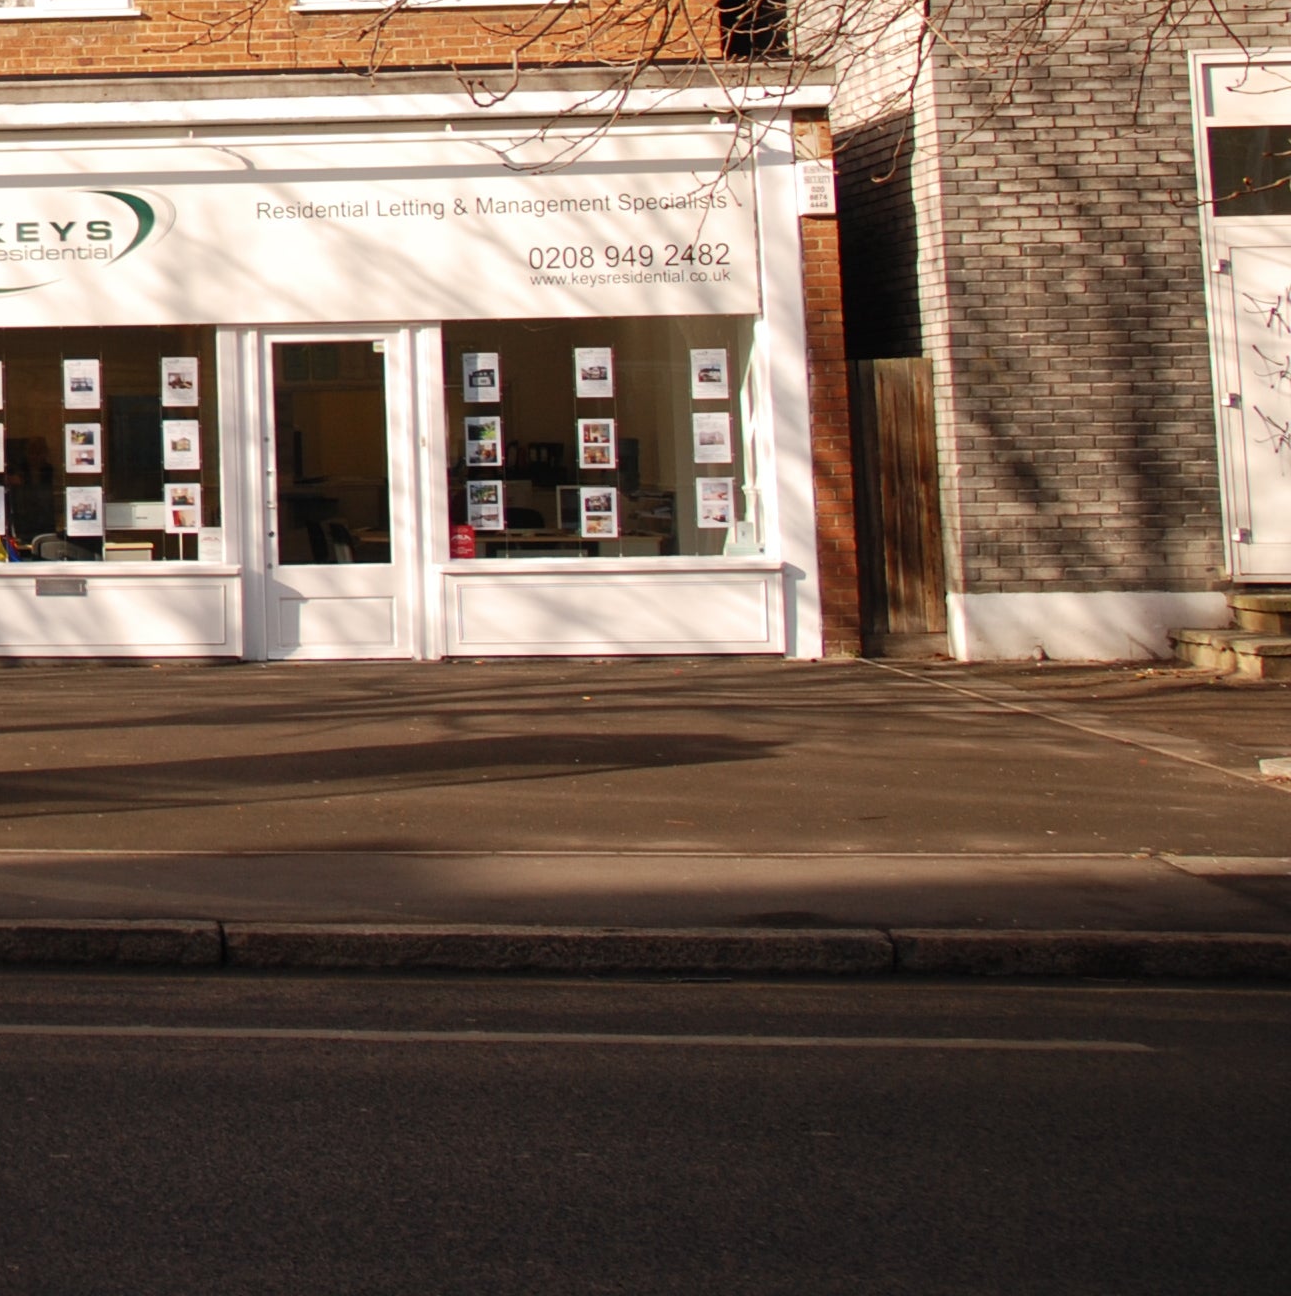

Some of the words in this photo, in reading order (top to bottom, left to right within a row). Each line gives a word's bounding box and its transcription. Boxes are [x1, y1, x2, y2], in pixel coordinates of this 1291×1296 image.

[256, 200, 369, 219] Residential
[377, 198, 445, 220] Letting
[453, 197, 469, 216] &
[476, 194, 611, 218] Management
[618, 192, 728, 215] Specialists
[528, 246, 595, 270] 0208
[604, 244, 654, 268] 949
[664, 242, 731, 267] 2482
[530, 268, 731, 288] www.keysresidential.co.uk
